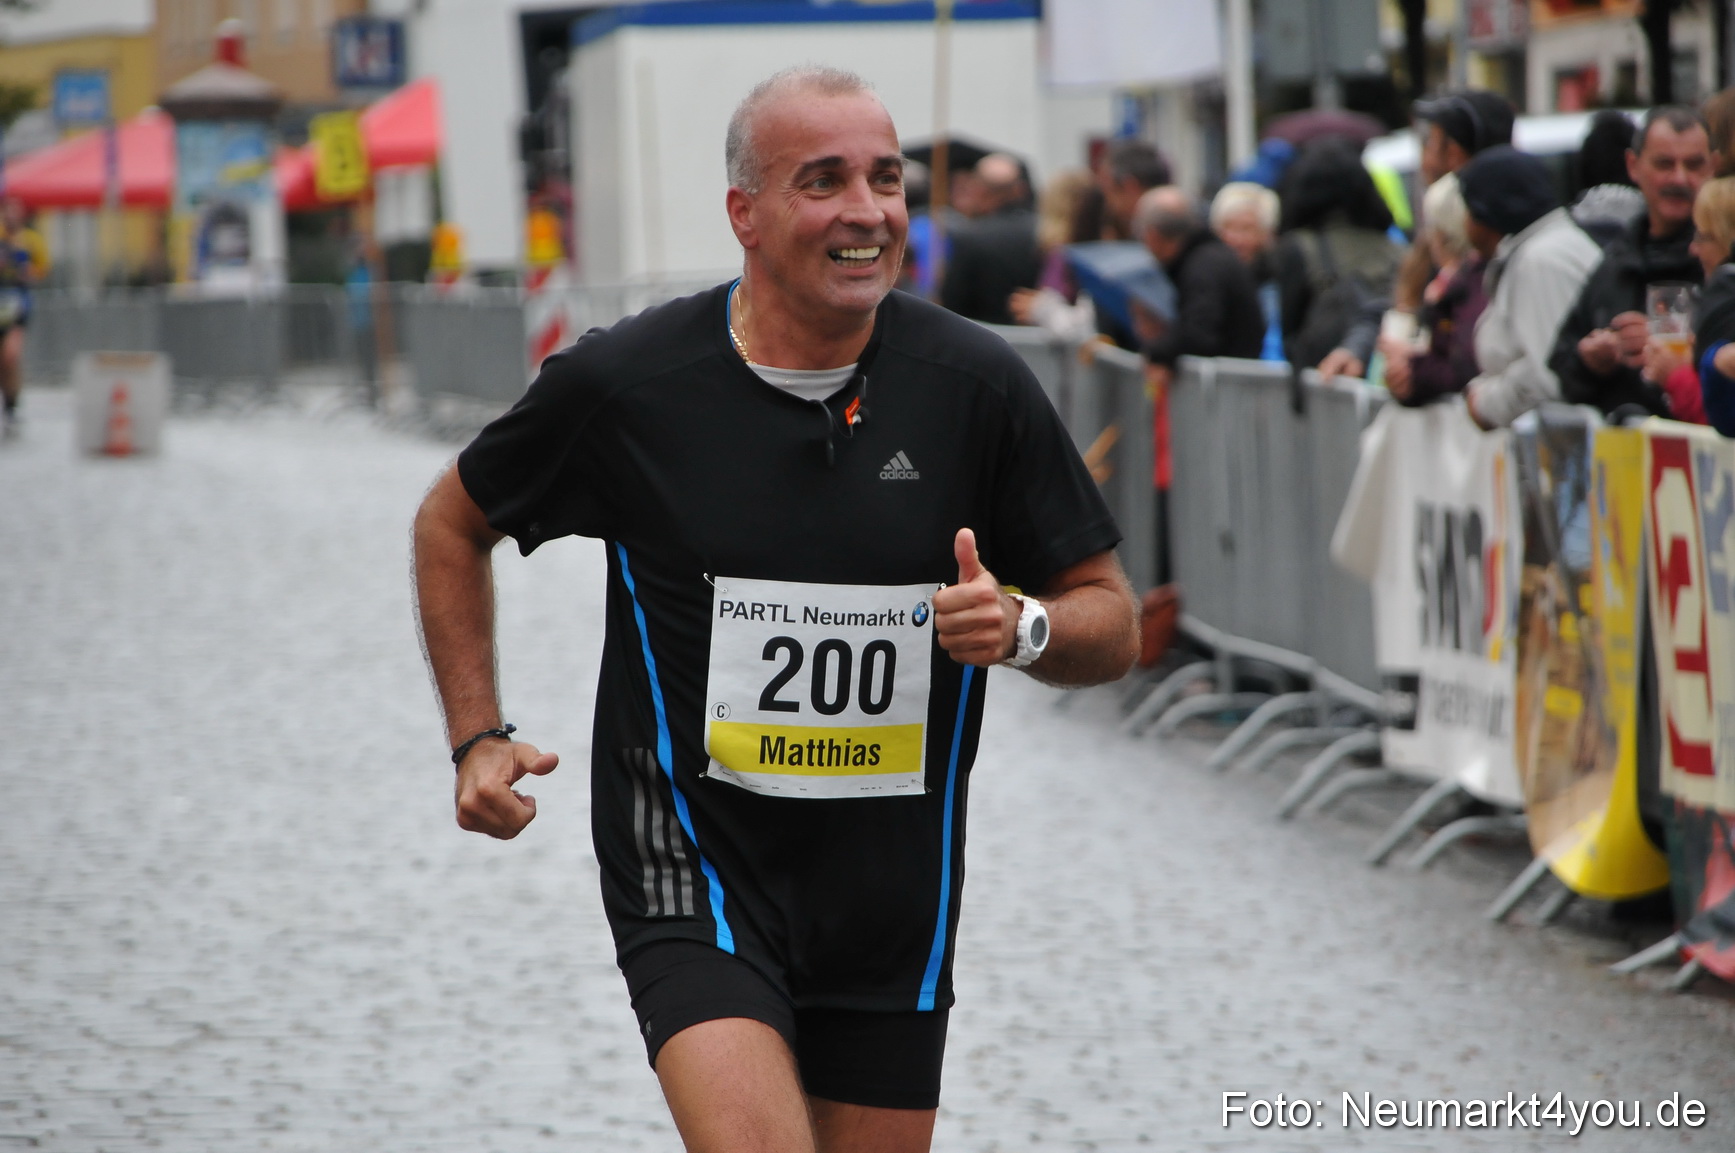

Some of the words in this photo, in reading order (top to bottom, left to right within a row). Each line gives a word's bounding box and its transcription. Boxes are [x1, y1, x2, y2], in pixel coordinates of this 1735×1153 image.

[880, 467, 920, 480] adidas
[719, 599, 796, 624] PARTL
[803, 606, 906, 627] Neumarkt
[758, 636, 897, 716] 200
[759, 735, 881, 767] Matthias
